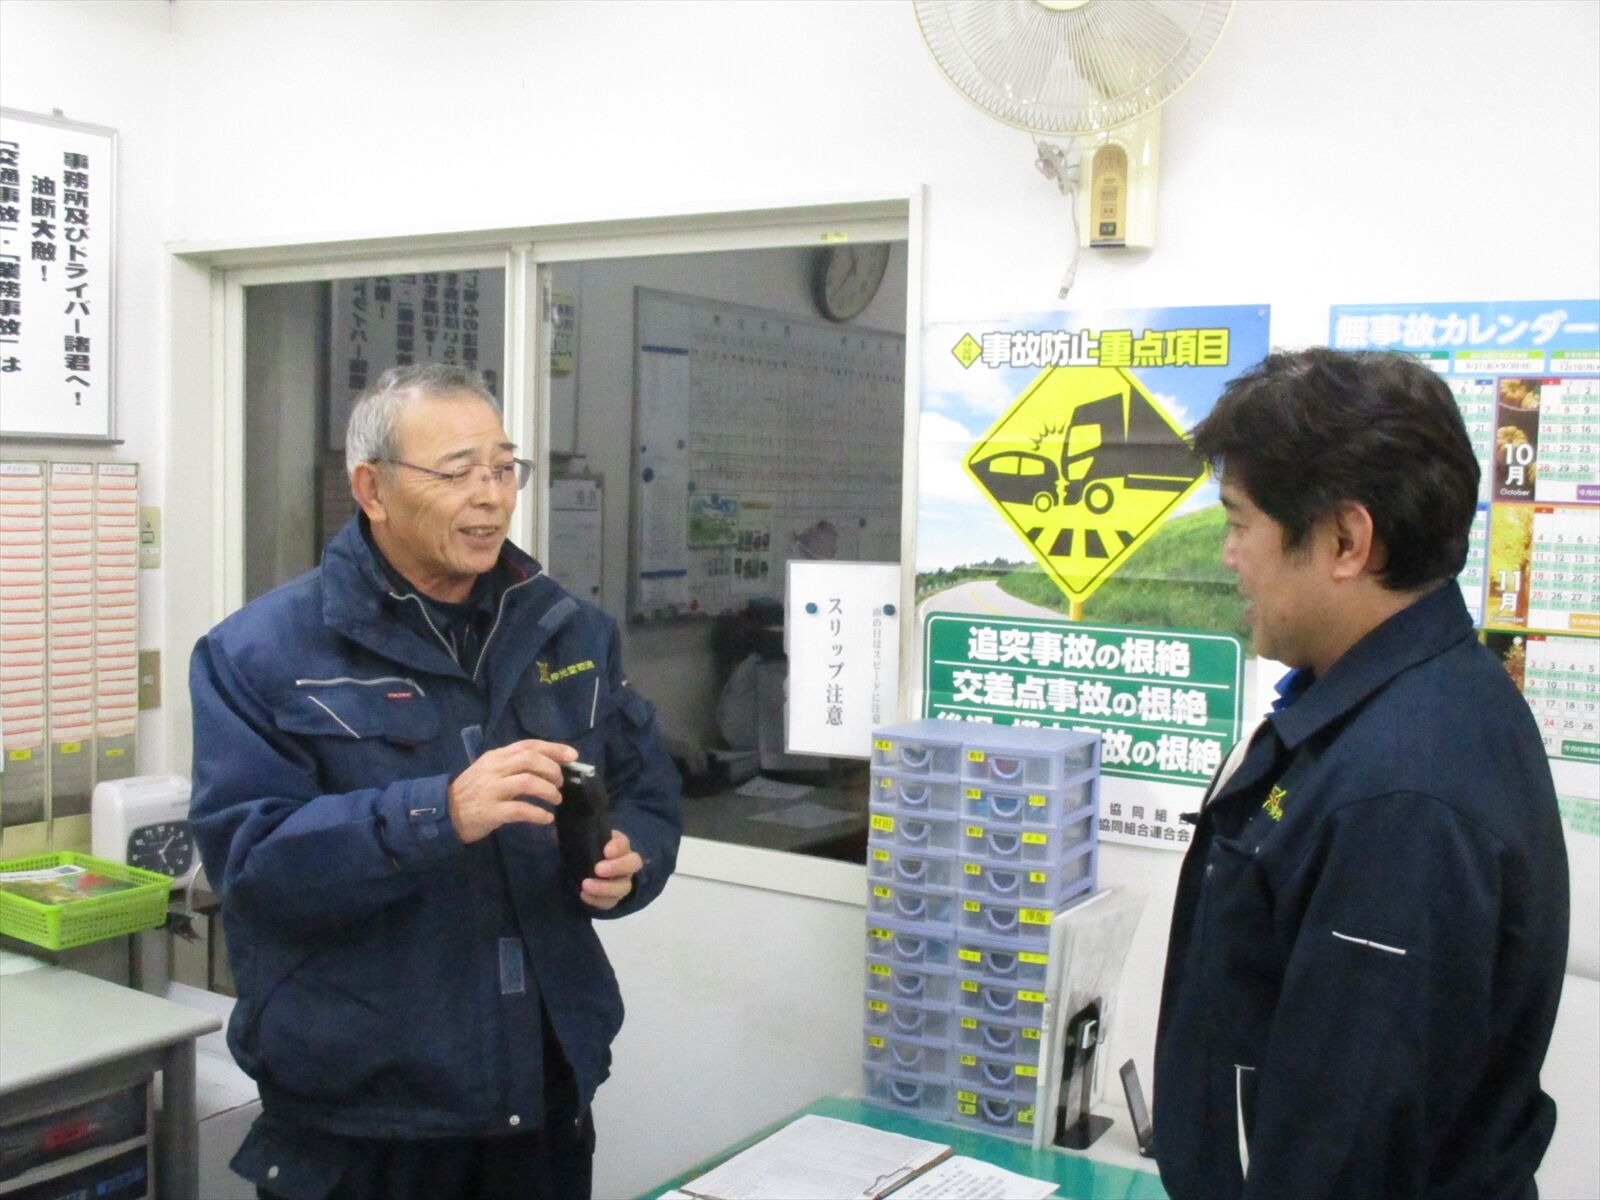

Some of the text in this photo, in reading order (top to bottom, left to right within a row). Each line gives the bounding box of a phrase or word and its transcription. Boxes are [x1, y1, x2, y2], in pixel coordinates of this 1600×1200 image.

[1335, 310, 1600, 349] 無事故カレンダー
[982, 328, 1231, 369] 事故防止重点項目
[1504, 443, 1533, 465] 10
[1505, 466, 1524, 485] 月
[1500, 488, 1530, 496] October
[1498, 570, 1521, 591] 11
[1499, 592, 1517, 611] 月
[826, 597, 844, 726] スリップ注意
[968, 626, 1190, 678] 追突事故の根絶
[952, 669, 1208, 727] 交差点事故の根絶
